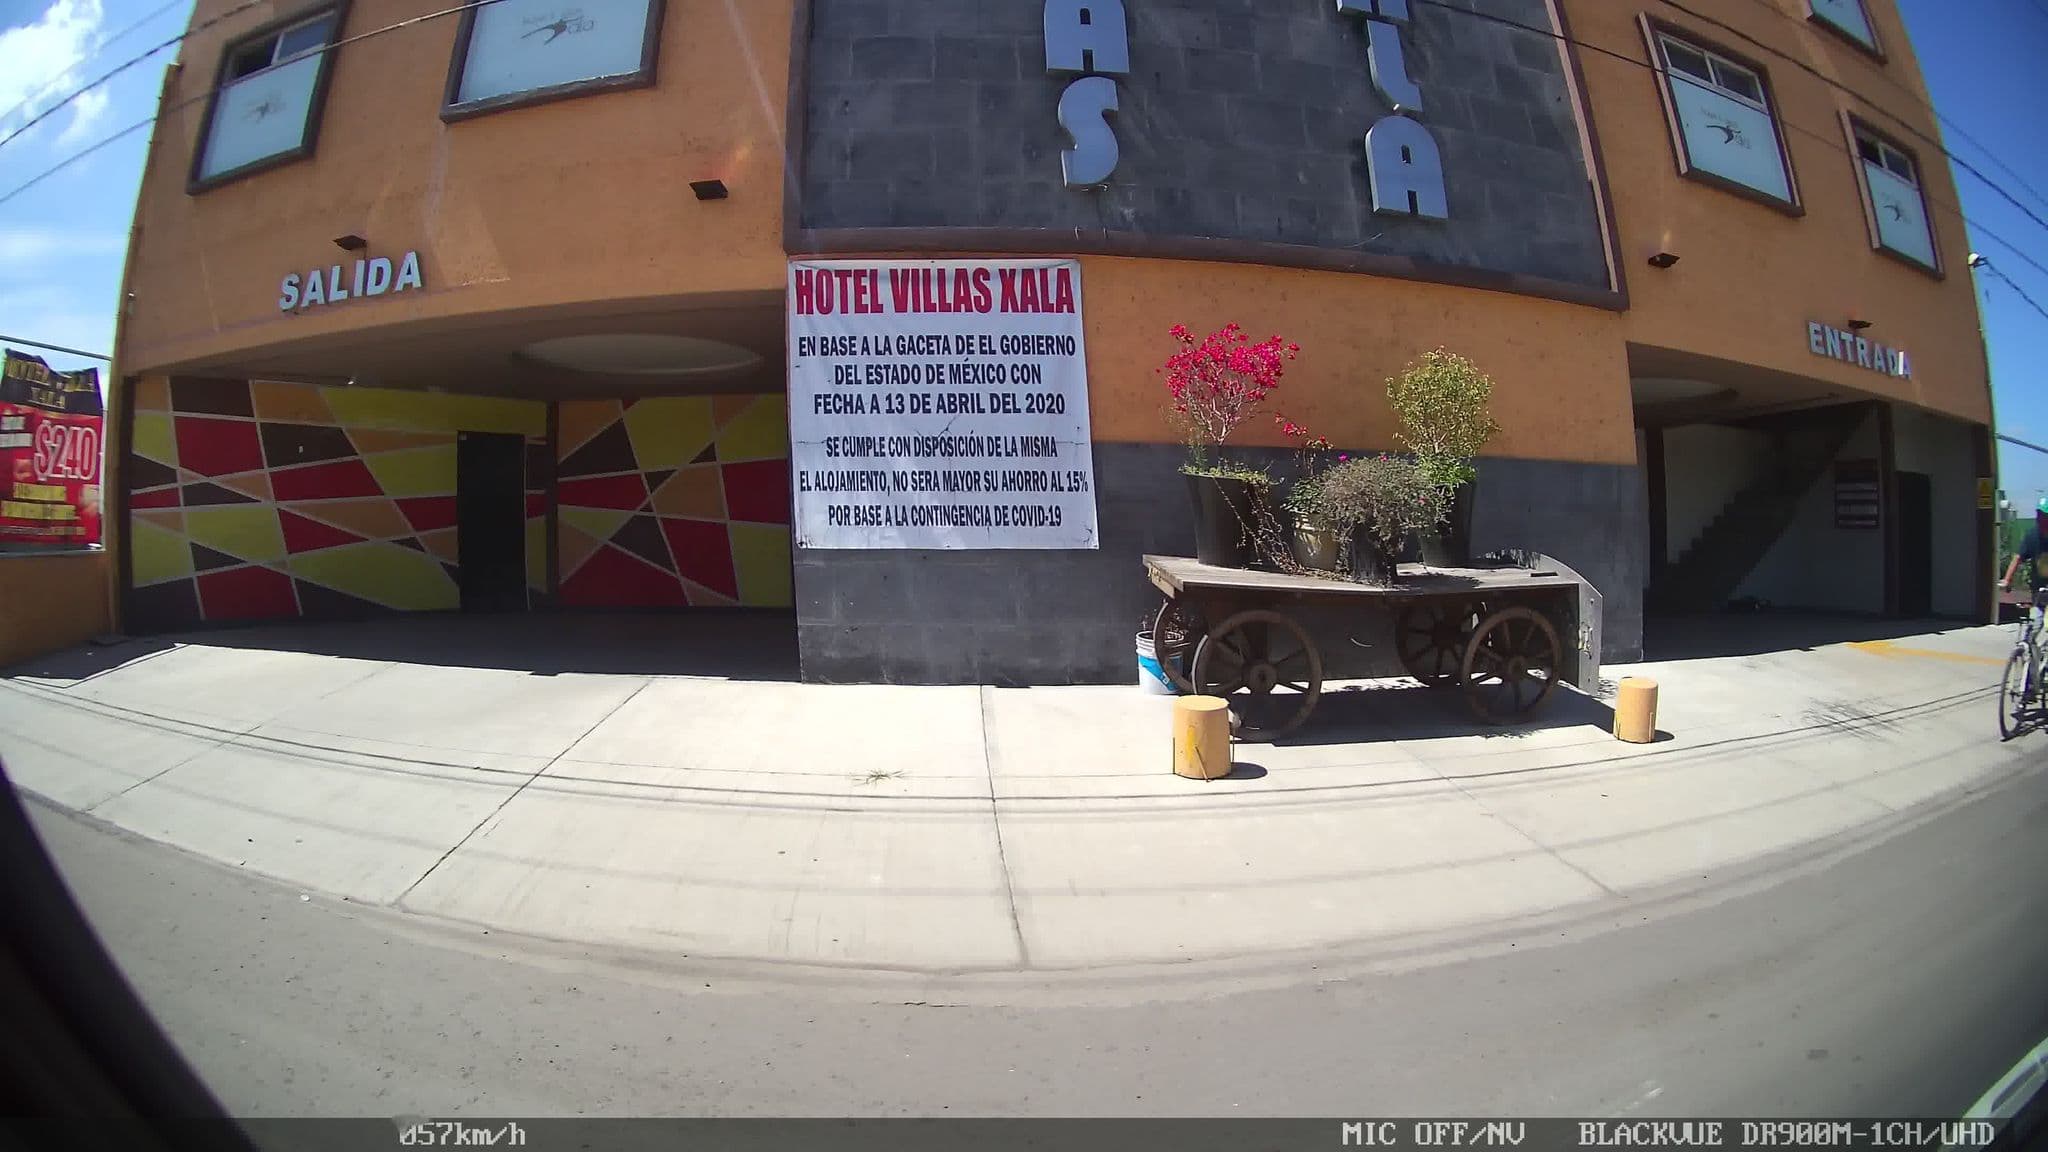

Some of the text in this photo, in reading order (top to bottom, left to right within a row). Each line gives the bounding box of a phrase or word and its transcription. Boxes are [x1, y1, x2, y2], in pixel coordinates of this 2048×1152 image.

[279, 251, 422, 310] SALIDA
[795, 268, 1075, 315] HOTEL VILLAS XALA
[799, 334, 1076, 357] EN BASE A LA GACETA DE EL GOBIERNO
[1808, 321, 1913, 380] ENTRADA
[834, 357, 1042, 385] DEL ESTADO DE MÉXICO CON
[814, 393, 1066, 415] FECHA A 13 DE ABRIL DEL 2020
[34, 420, 98, 482] $240
[826, 430, 1058, 458] SE CUMPLE CON DISPOSICIÓN DE LA MISMA
[800, 470, 1089, 497] EL ALOJAMIENTO, NO SERA MAYOR SU AHORRO AL 15%
[828, 505, 1062, 527] POR BASE A LA CONTINGENCIA DE COVID-19
